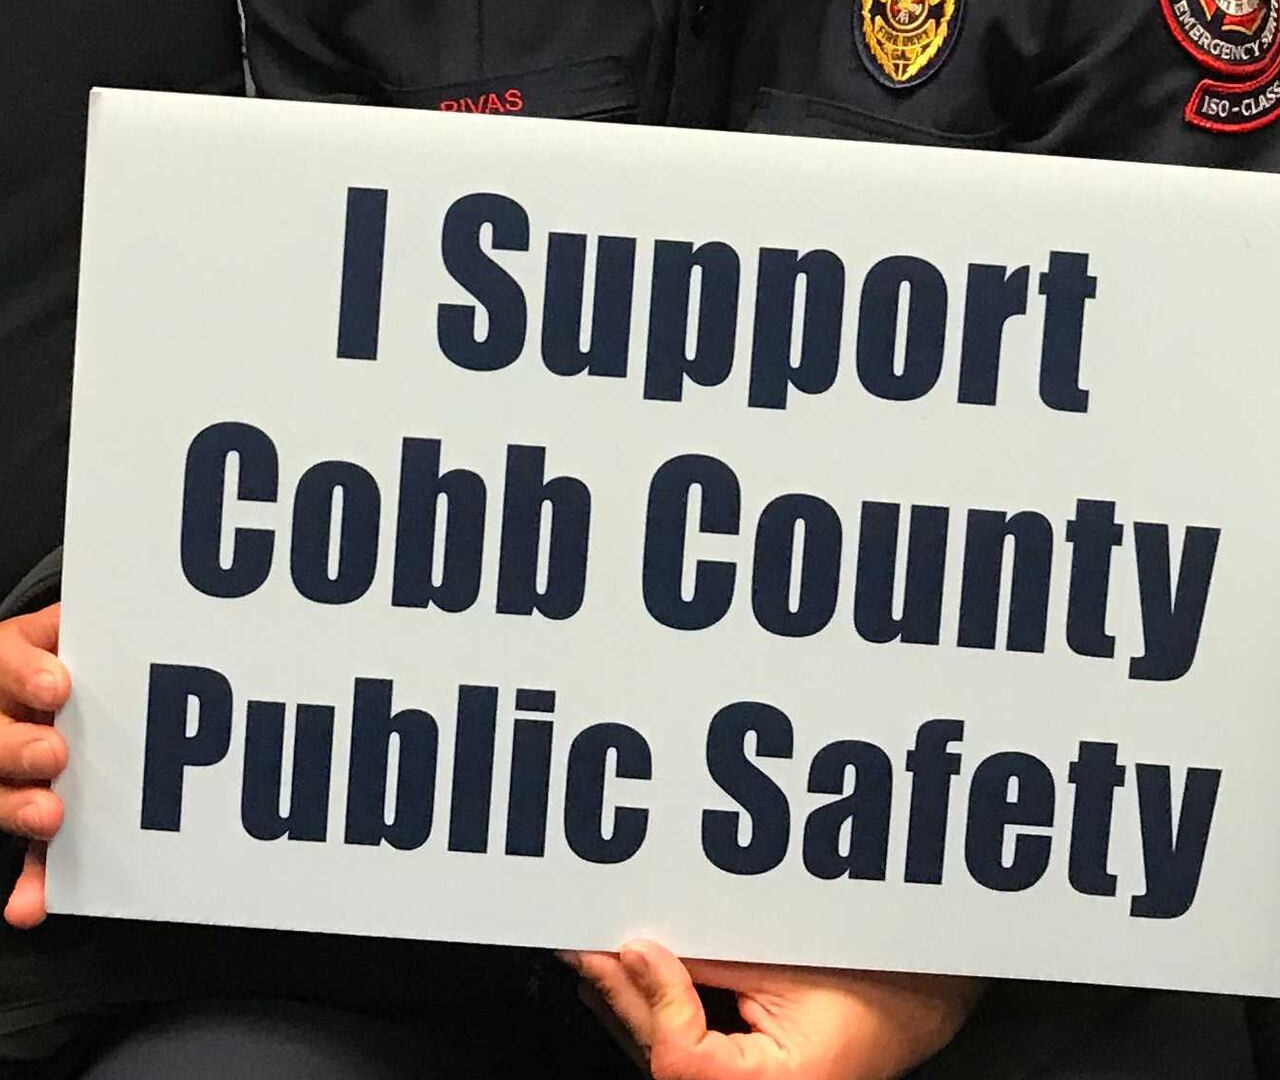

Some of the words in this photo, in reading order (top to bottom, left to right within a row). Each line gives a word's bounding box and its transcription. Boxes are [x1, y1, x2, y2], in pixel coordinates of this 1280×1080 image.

[877, 26, 899, 45] FIRE
[336, 187, 389, 360] I
[437, 192, 1098, 414] Support
[180, 421, 591, 620] Cobb
[642, 454, 1221, 682] County
[140, 663, 653, 865] Public
[701, 701, 1223, 920] Safety
